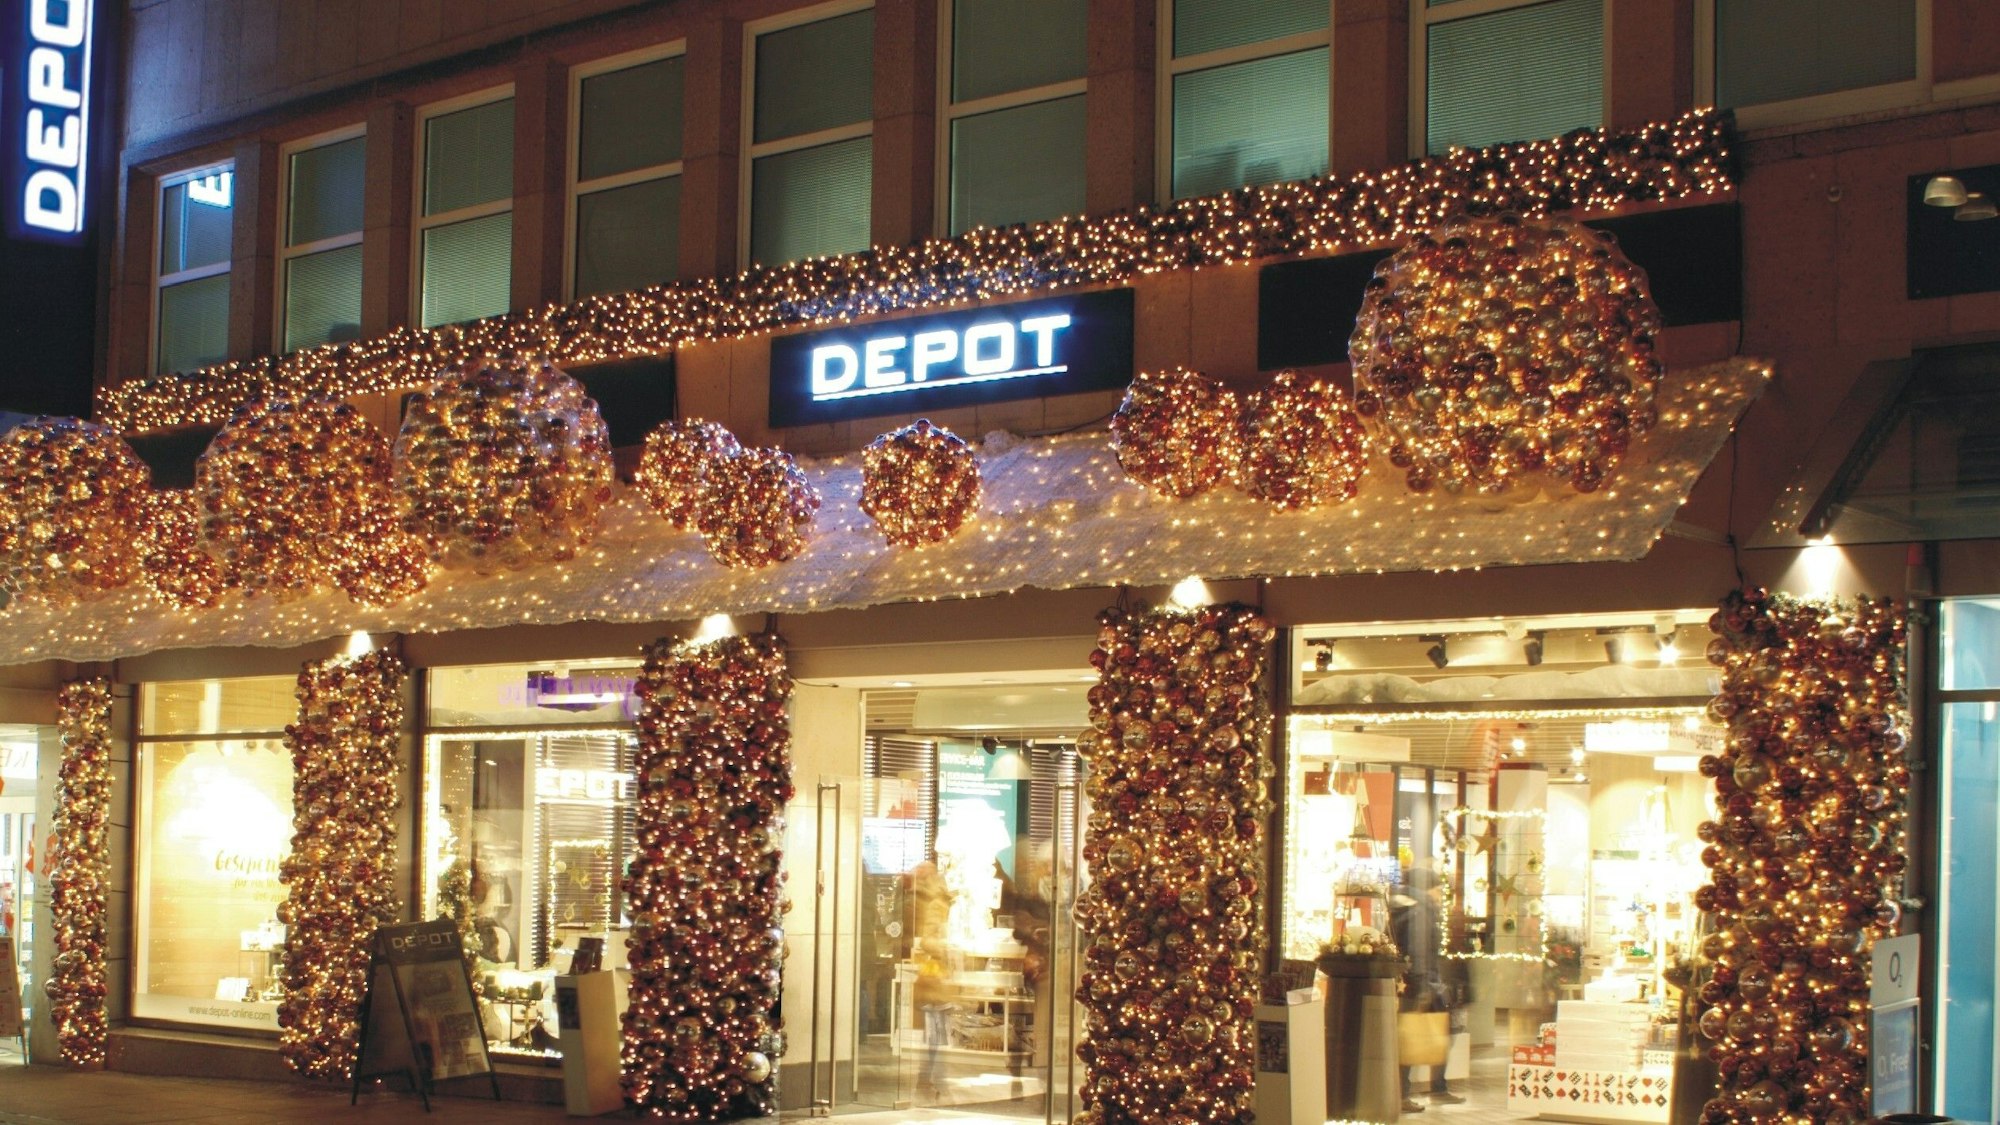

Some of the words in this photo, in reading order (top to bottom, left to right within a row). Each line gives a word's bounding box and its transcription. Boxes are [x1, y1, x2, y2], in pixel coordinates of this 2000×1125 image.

[812, 314, 1071, 395] DEPOT
[391, 931, 454, 949] DEPOT
[188, 1005, 271, 1022] www.depot-online.com
